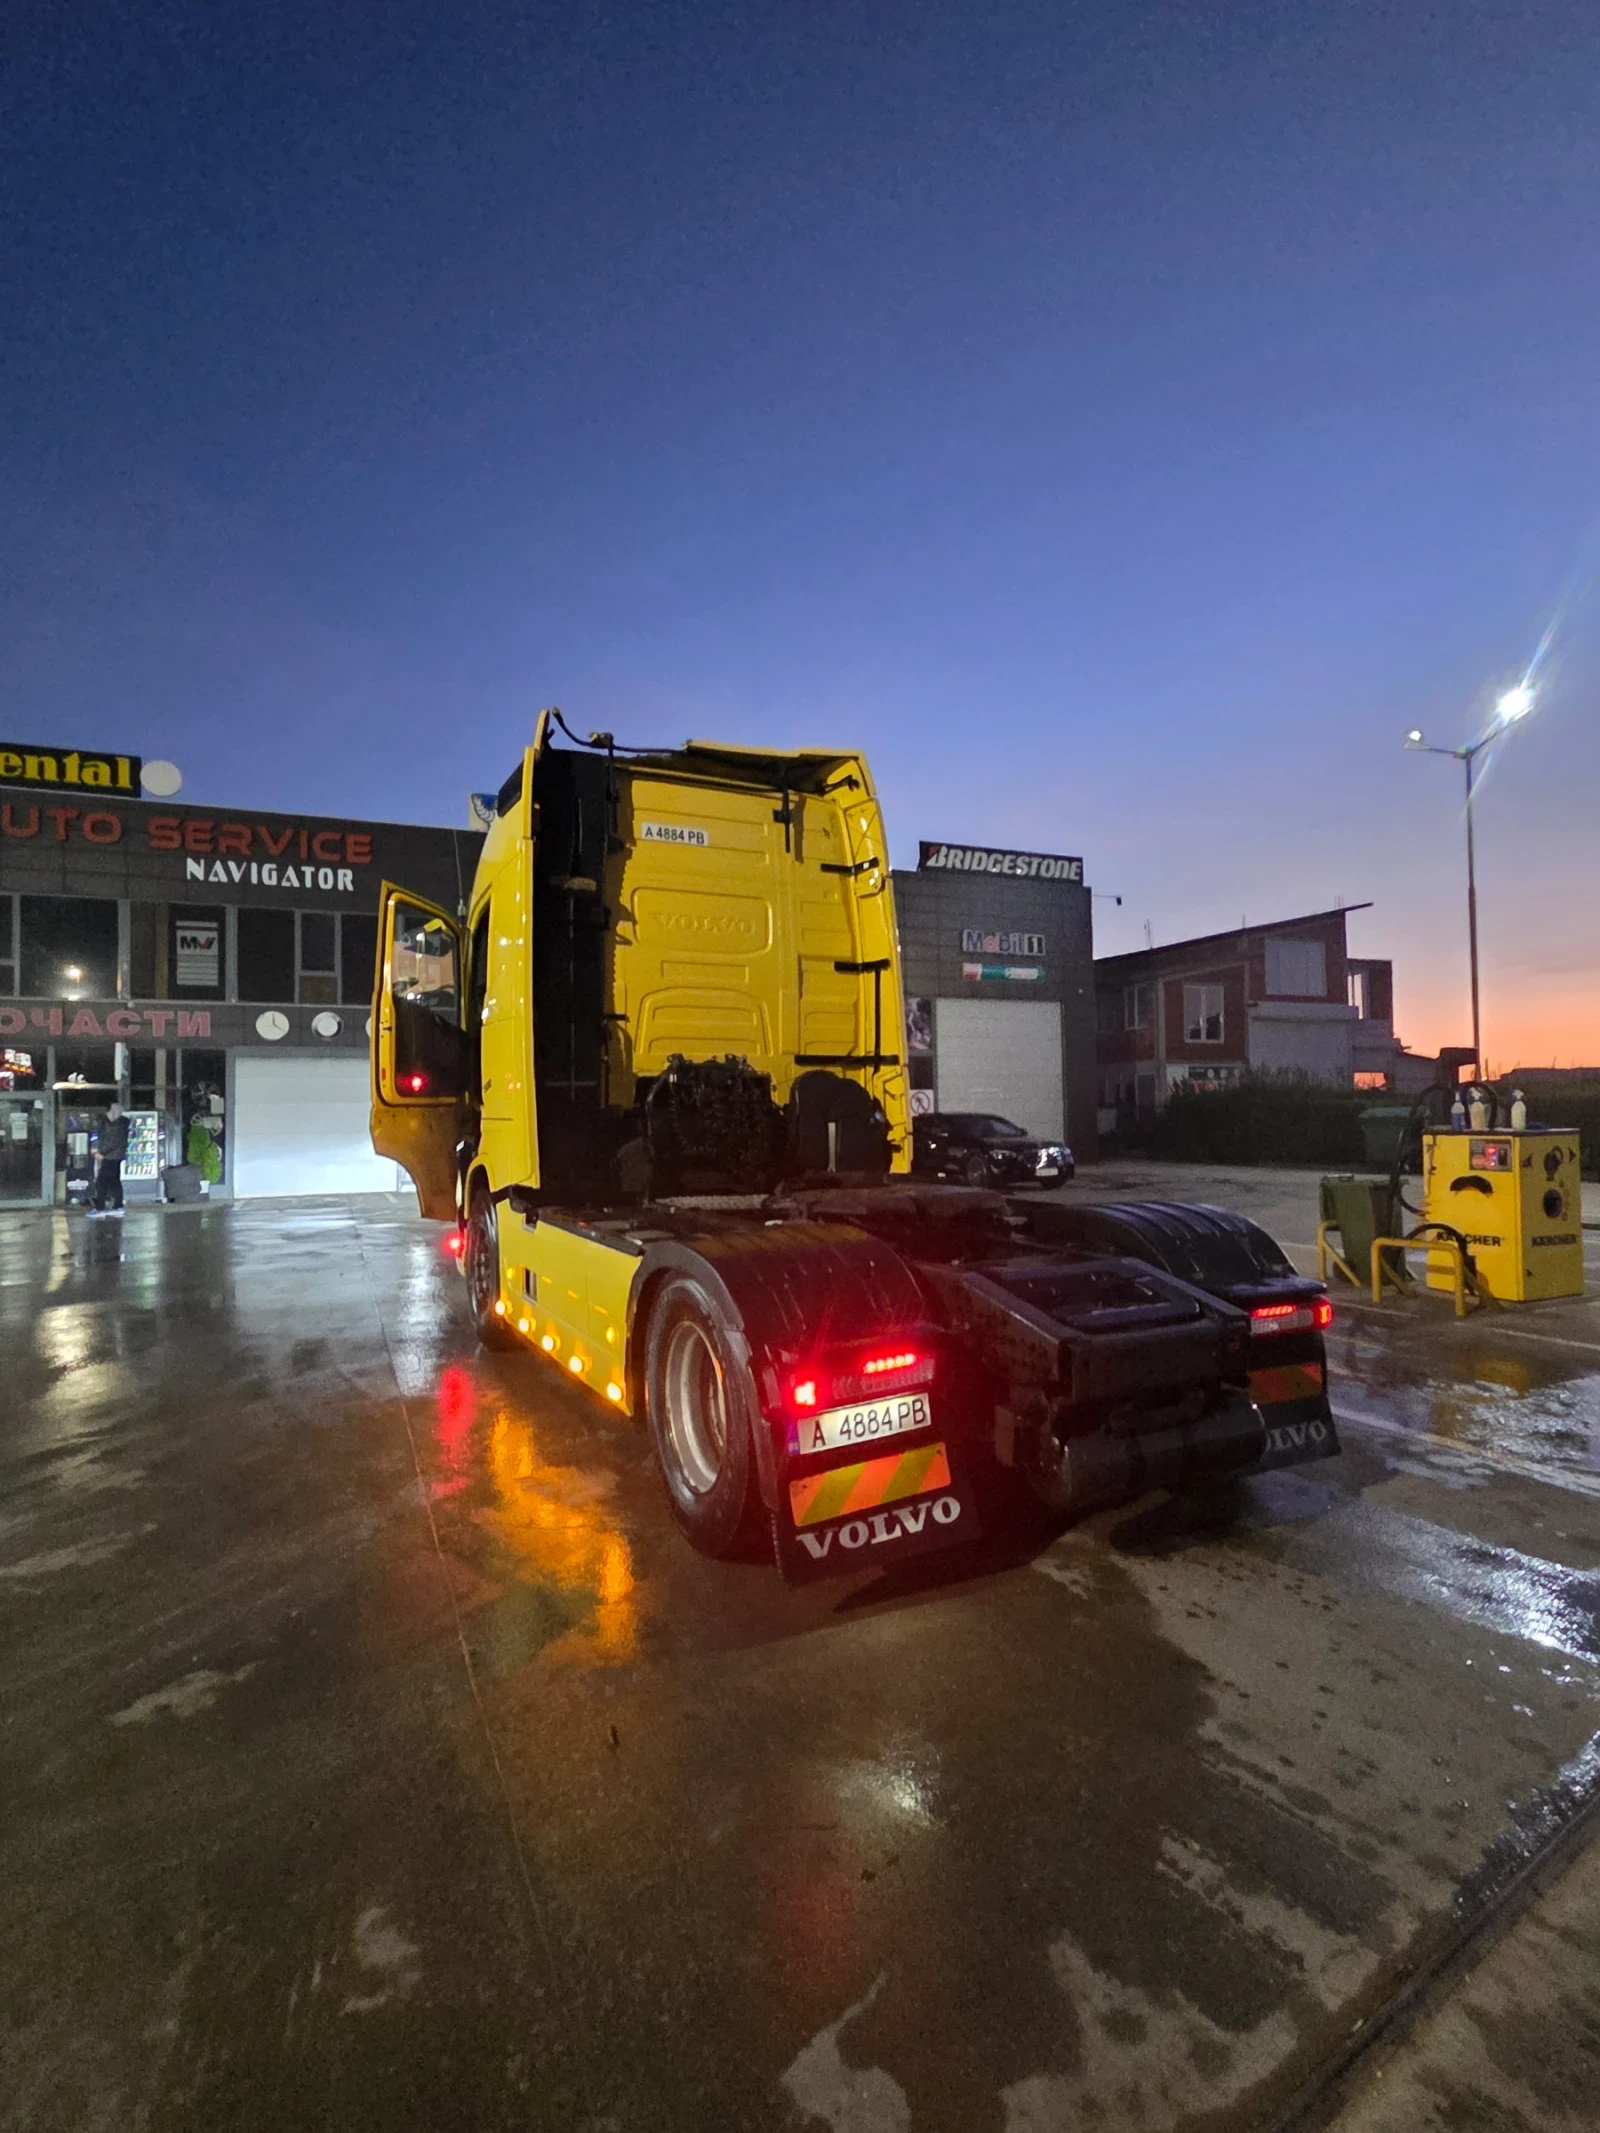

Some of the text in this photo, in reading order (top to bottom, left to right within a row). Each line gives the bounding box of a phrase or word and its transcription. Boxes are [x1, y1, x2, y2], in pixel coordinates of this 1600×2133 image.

[0, 752, 132, 789] ental
[2, 803, 374, 864] UTO SERVICE
[645, 826, 706, 845] A 4884 PB
[186, 857, 355, 892] NAVIGATOR
[926, 844, 1083, 881] BRIDGESTONE
[962, 929, 1023, 955] Mobil
[0, 1006, 212, 1038] ОЧАСТИ
[1436, 1230, 1502, 1248] KCHER
[811, 1397, 927, 1449] A 4884 PB
[795, 1496, 962, 1560] VOLVO
